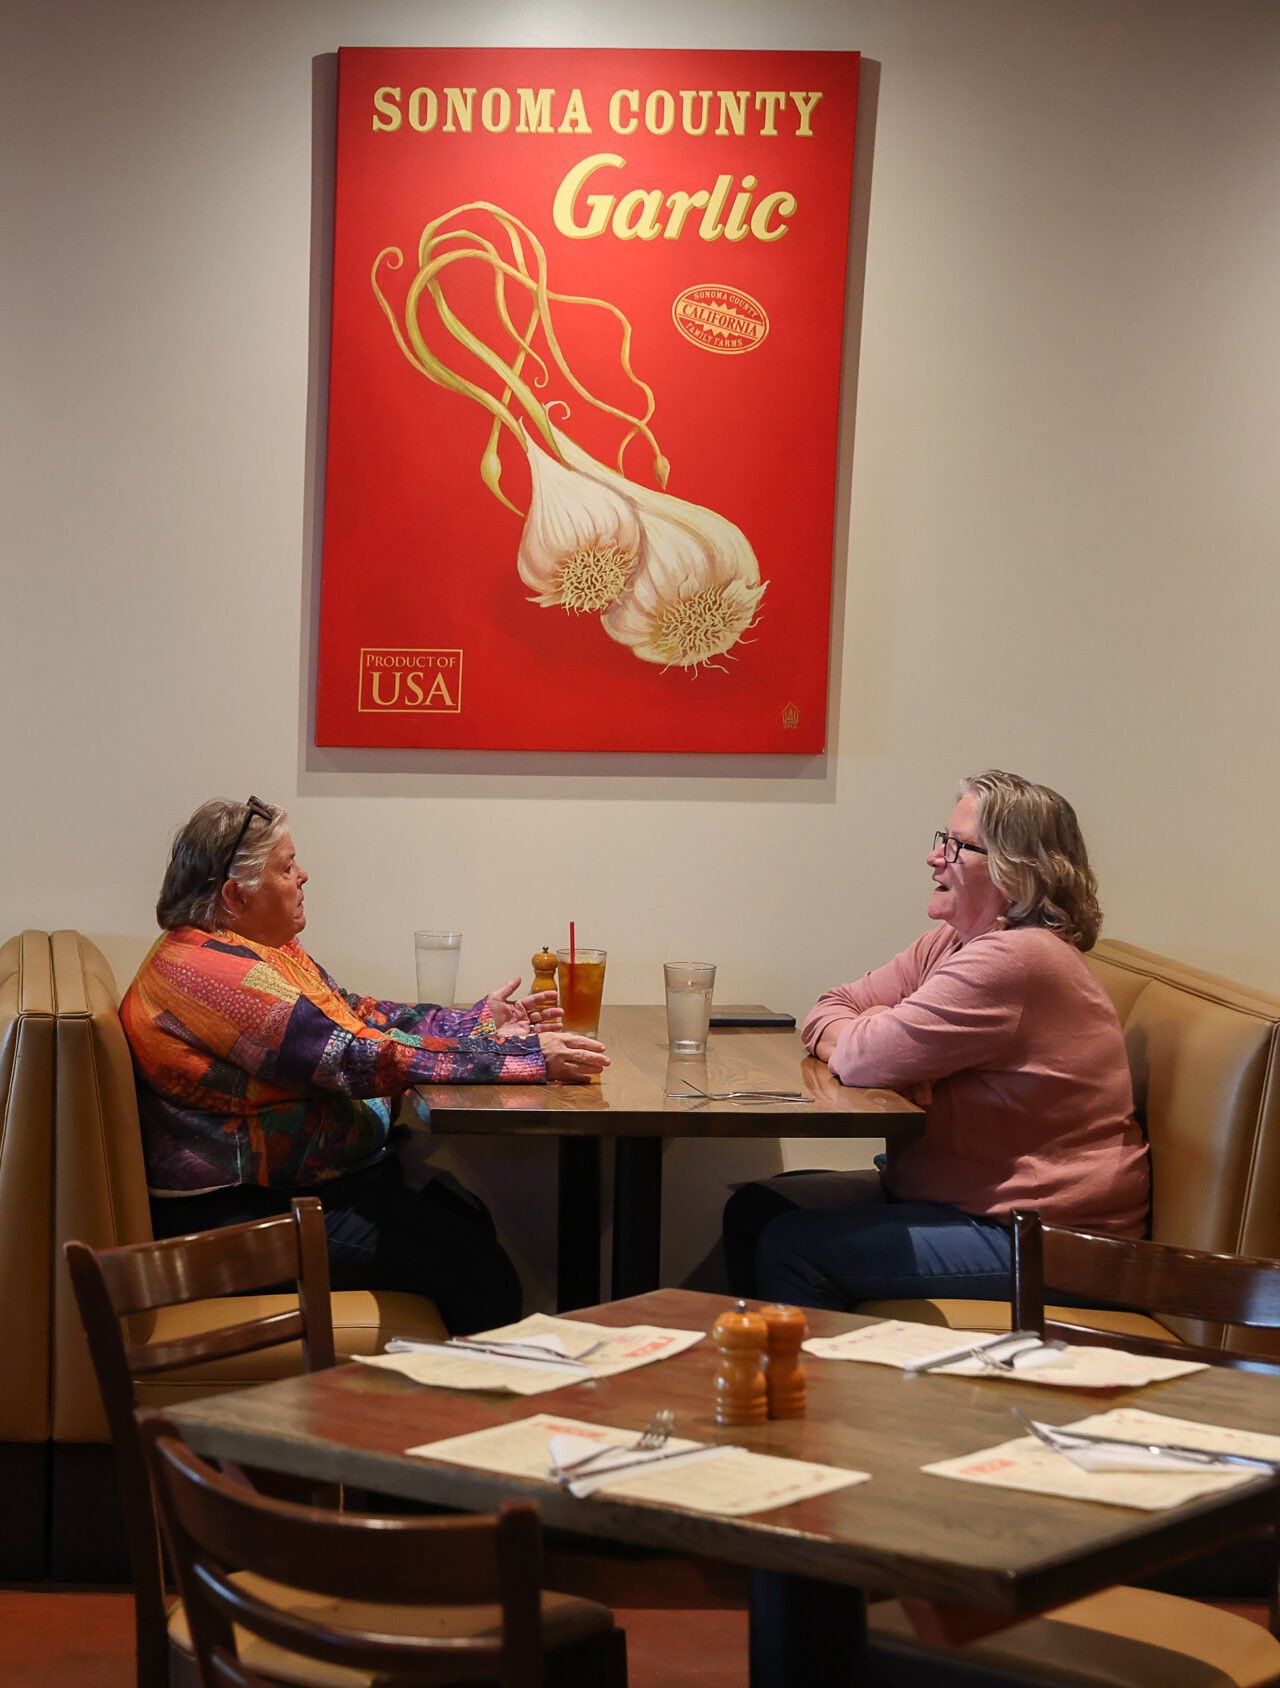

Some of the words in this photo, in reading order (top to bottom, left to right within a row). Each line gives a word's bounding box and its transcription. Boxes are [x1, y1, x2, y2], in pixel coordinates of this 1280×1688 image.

[372, 86, 591, 134] SONOMA
[609, 89, 822, 136] COUNTY
[552, 153, 797, 242] Garlic
[682, 303, 757, 337] CALIFORNIA
[693, 291, 727, 300] SONOMA
[729, 295, 758, 318] COUNTY
[686, 322, 713, 343] FAMILY
[714, 339, 743, 348] FARMS
[437, 656, 456, 668] OF
[370, 671, 457, 706] USA
